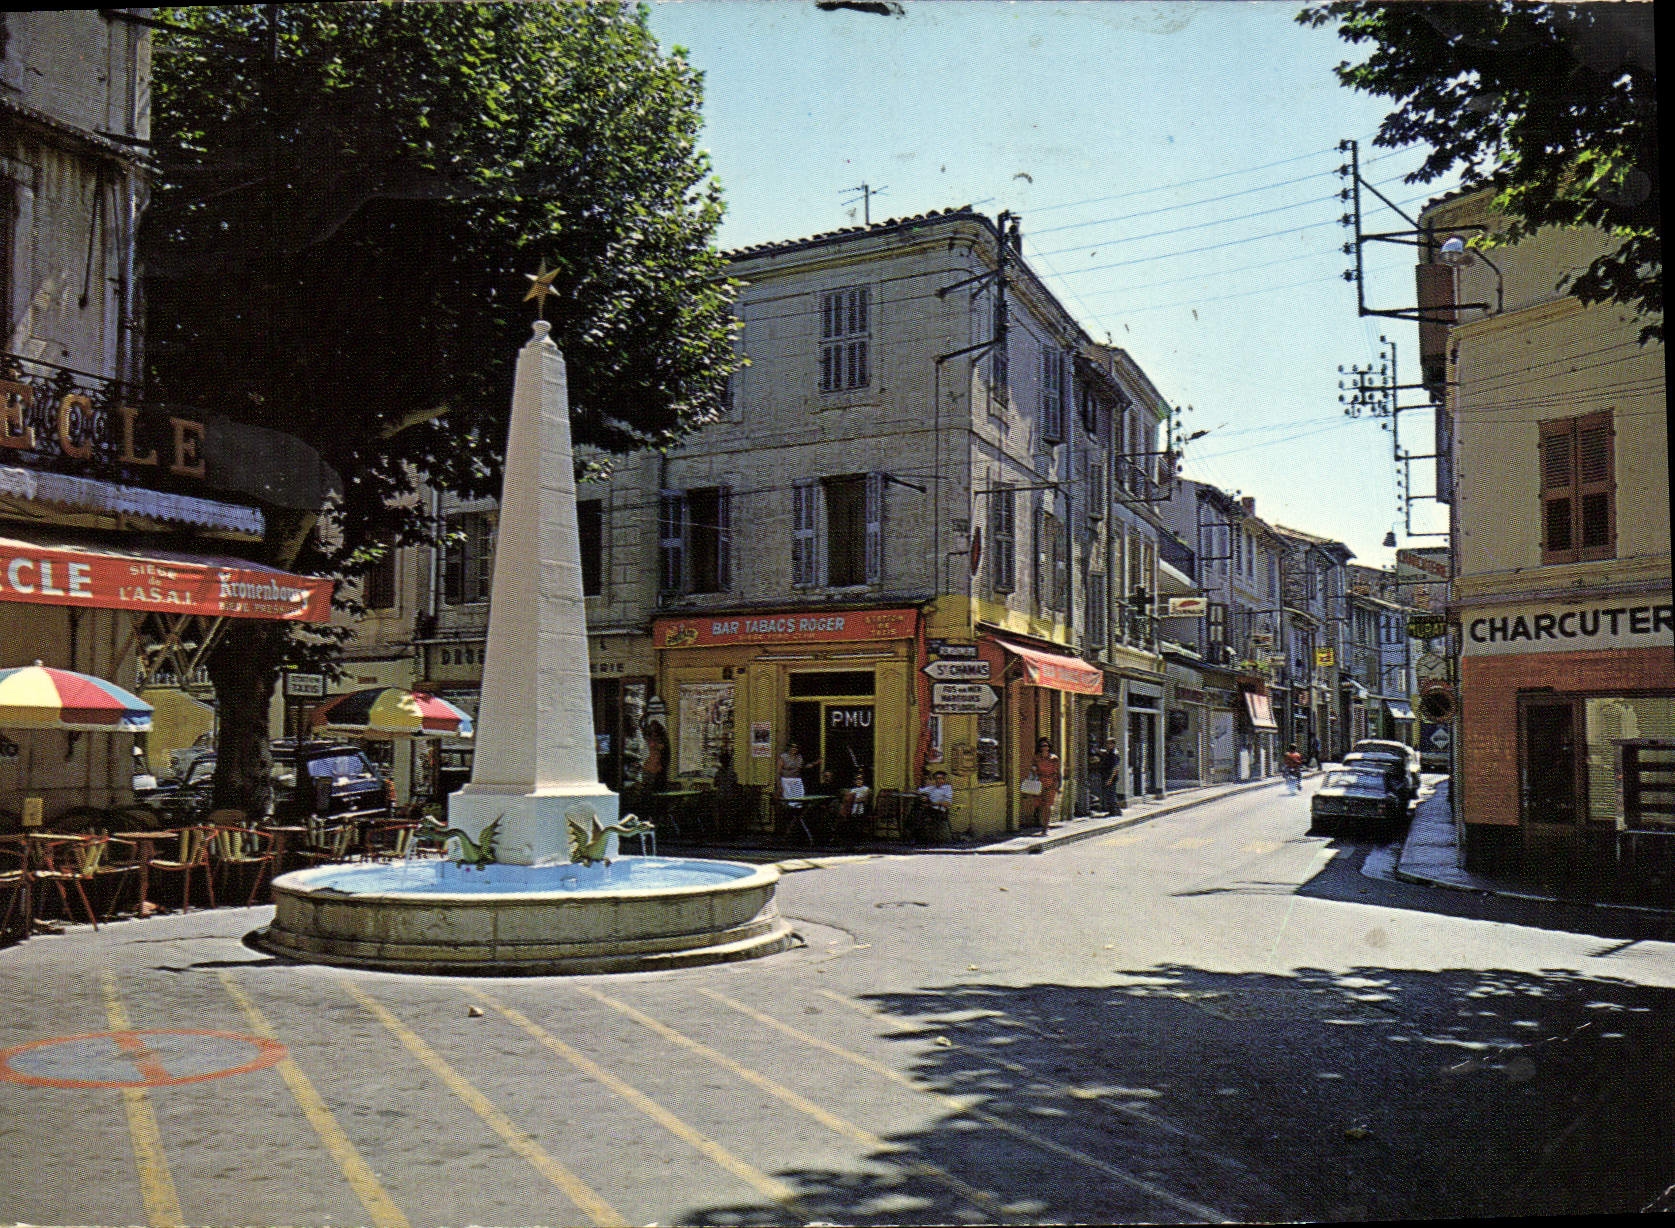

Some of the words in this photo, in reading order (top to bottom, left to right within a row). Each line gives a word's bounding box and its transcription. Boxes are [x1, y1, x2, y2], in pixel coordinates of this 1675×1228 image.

[0, 557, 93, 598] CLE
[711, 621, 739, 635] BAR
[745, 618, 796, 633] TABACS
[799, 617, 846, 631] ROGER
[1469, 604, 1673, 643] CHARCUTER
[949, 664, 989, 676] CHAMAS
[831, 710, 872, 728] PMU
